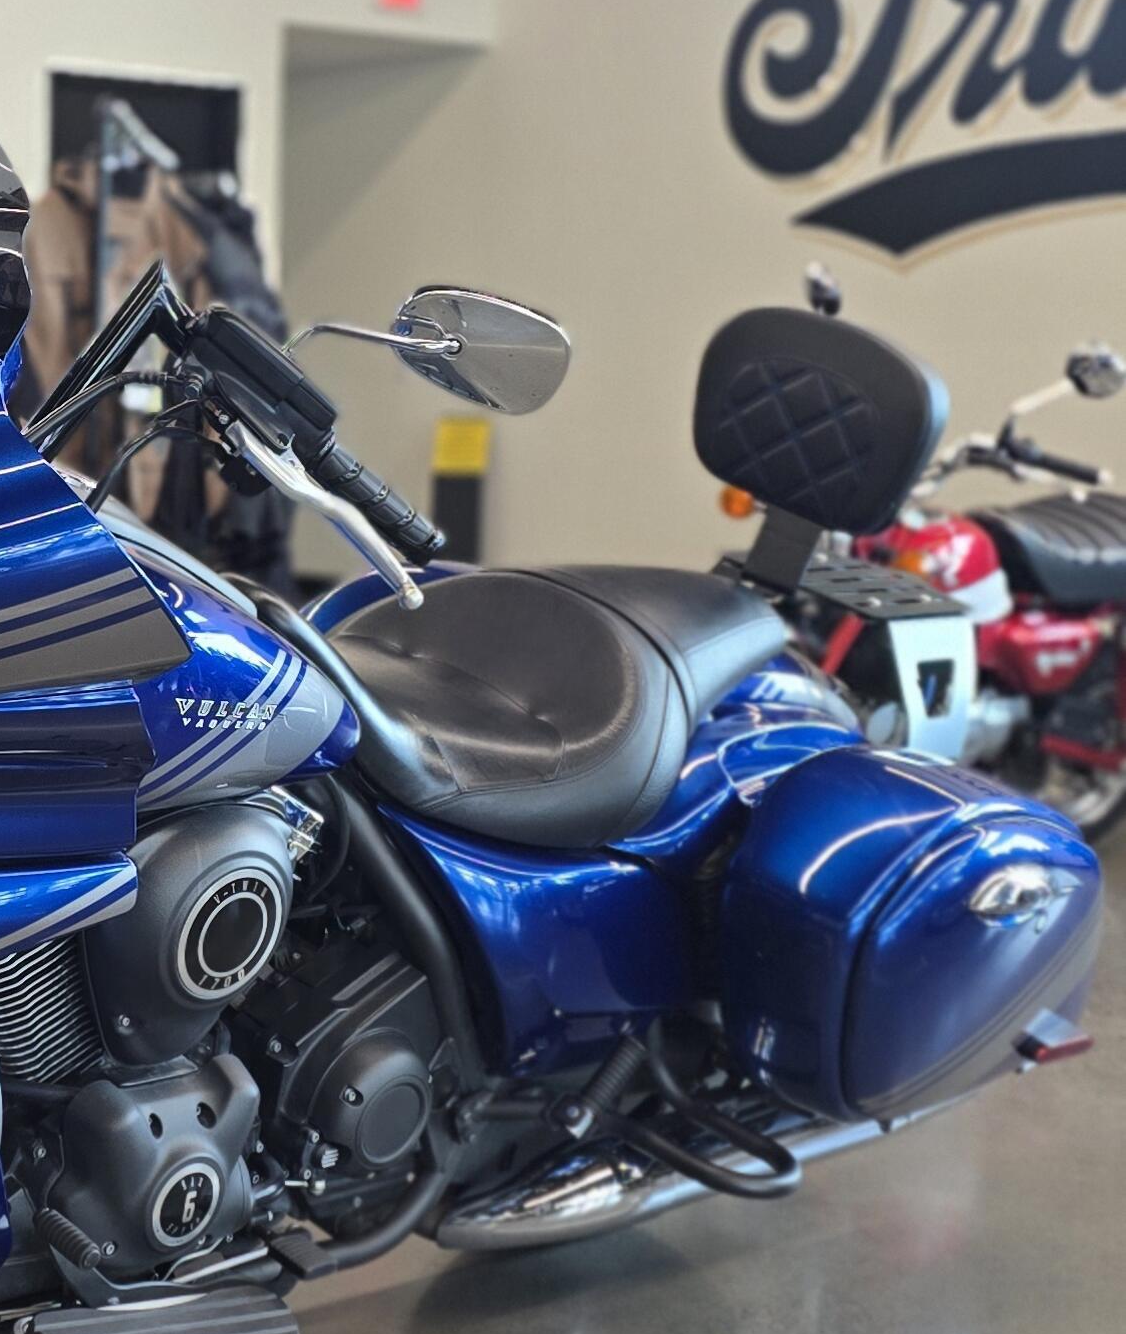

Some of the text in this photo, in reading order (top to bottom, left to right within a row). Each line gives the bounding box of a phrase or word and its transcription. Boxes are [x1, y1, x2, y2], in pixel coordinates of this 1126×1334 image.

[175, 697, 278, 720] VULCAN
[182, 717, 267, 731] VAQUERO
[198, 968, 246, 990] 1700
[181, 1190, 198, 1224] 6
